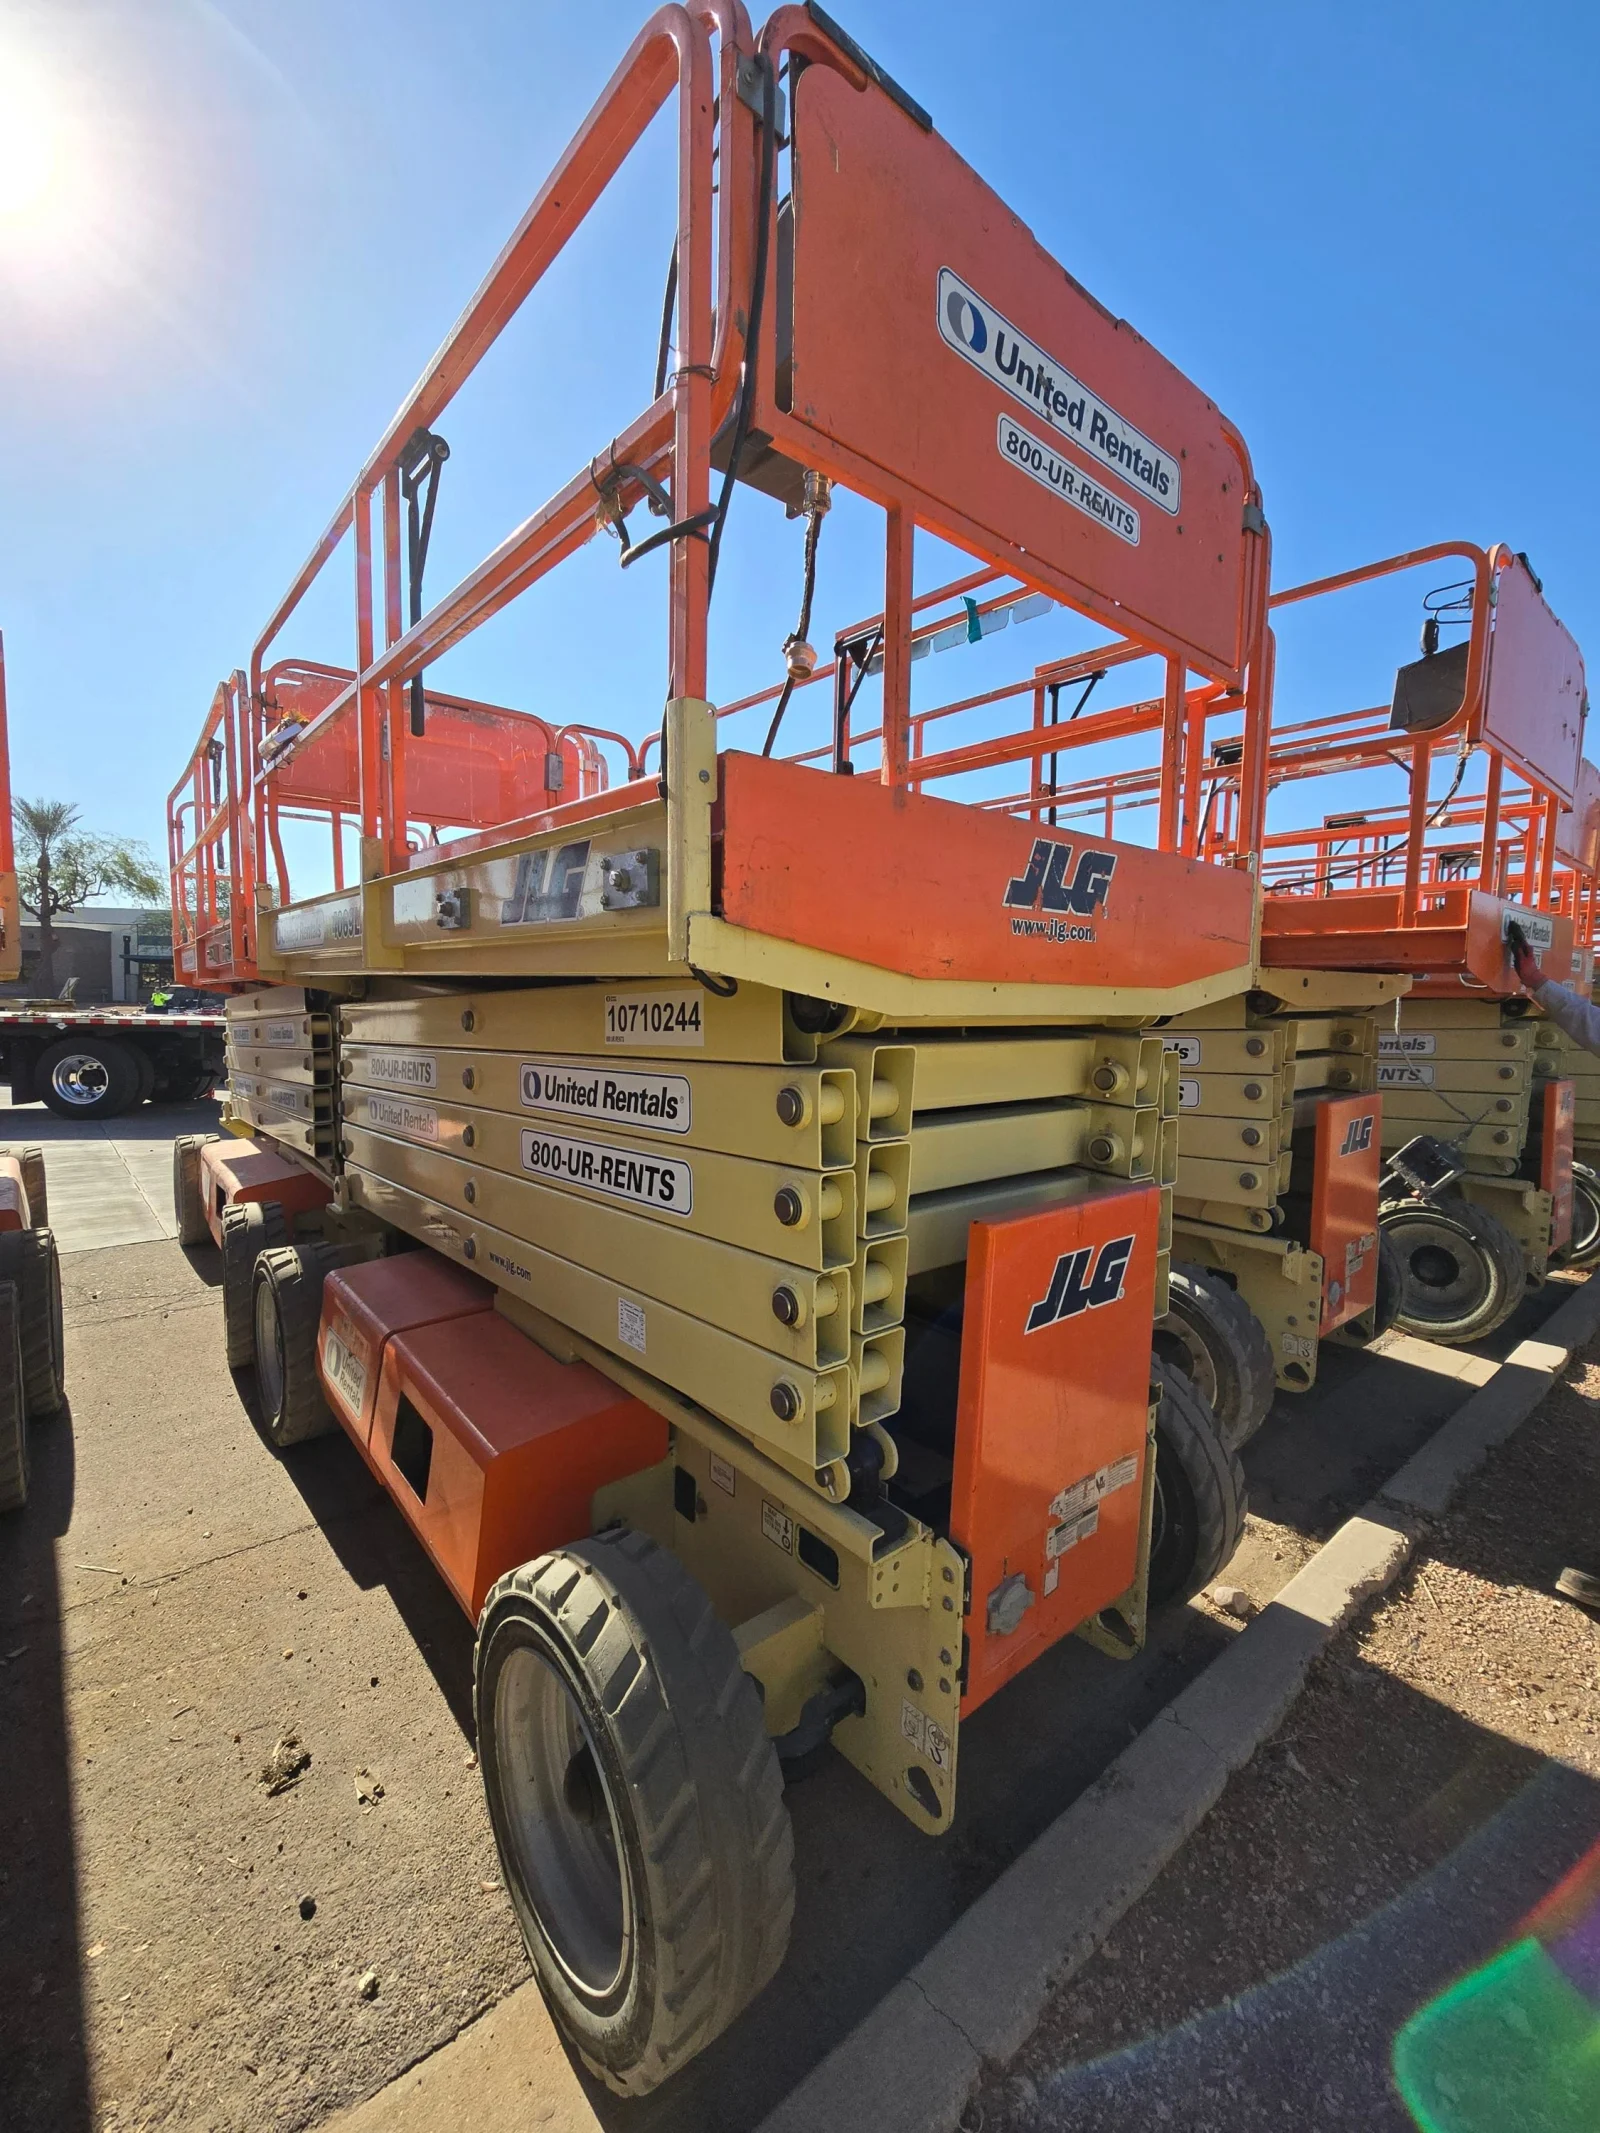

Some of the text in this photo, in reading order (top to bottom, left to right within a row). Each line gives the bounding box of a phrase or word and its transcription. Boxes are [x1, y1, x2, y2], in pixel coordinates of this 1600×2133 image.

[995, 330, 1170, 496] United Rentals
[1006, 431, 1135, 535] 800-UR-RENTS
[500, 839, 592, 927] JLG
[1002, 837, 1117, 918] JLG
[607, 1001, 701, 1032] 10710244
[1379, 1038, 1426, 1050] entals
[371, 1058, 432, 1083] 800-UR-RENTS
[544, 1074, 679, 1120] United Rentals
[379, 1104, 434, 1134] United Rentals
[1339, 1115, 1374, 1157] JLG
[530, 1140, 676, 1201] 800-UR-RENTS
[489, 1252, 532, 1281] www.jlg.com
[1024, 1234, 1136, 1335] JLG
[339, 1369, 361, 1410] Rentals
[341, 1355, 362, 1389] United
